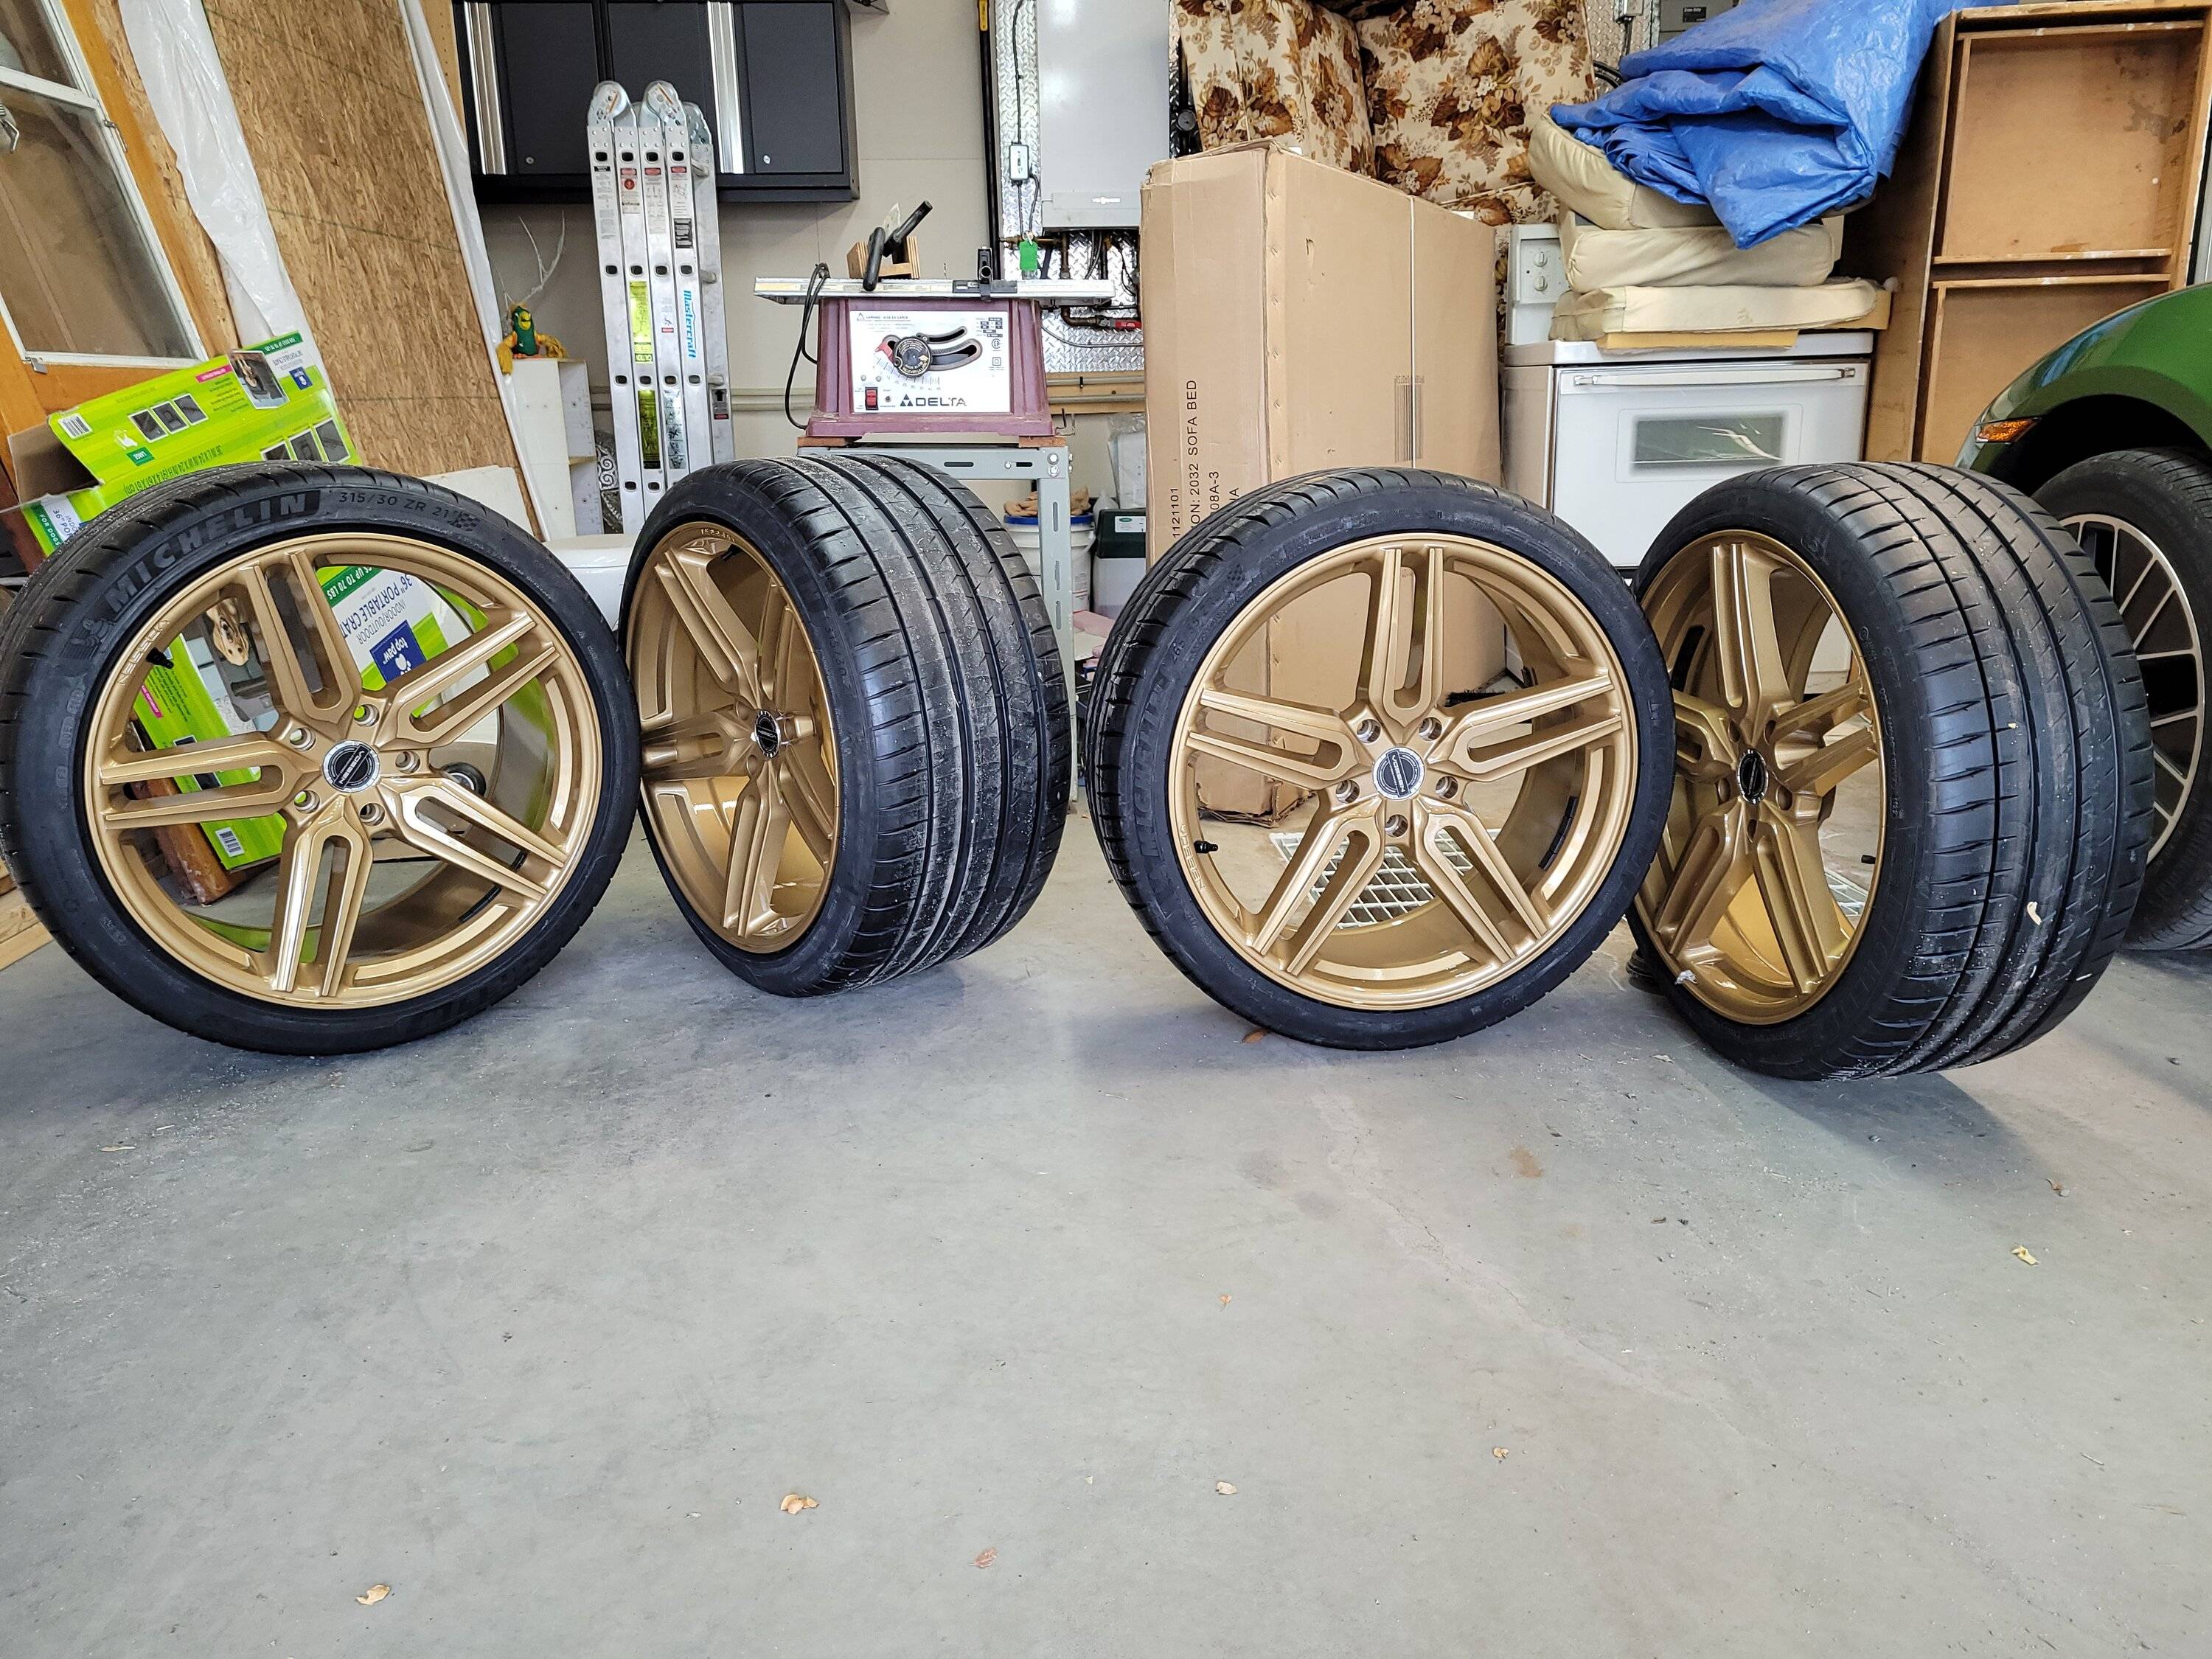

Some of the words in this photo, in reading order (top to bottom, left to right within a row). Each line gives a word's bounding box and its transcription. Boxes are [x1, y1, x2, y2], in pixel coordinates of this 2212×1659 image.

[684, 290, 696, 358] Mastercraft
[916, 397, 967, 406] DELTA
[1186, 380, 1197, 410] BED
[1187, 417, 1198, 456] SOFA
[1189, 463, 1200, 495] 2032
[40, 514, 50, 526] FOR
[338, 492, 397, 504] 315/30
[404, 498, 426, 512] ZR
[432, 507, 449, 518] 21
[104, 493, 307, 613] MICHELIN
[338, 580, 347, 591] 70
[348, 575, 357, 585] TO
[356, 568, 366, 580] UP
[327, 587, 339, 600] LBS
[358, 582, 400, 622] PORTABLE
[356, 600, 407, 644] INDOOR/OUTDOOR
[394, 636, 408, 652] top
[339, 751, 365, 785] VOSSEN
[1391, 754, 1405, 793] VOSSEN
